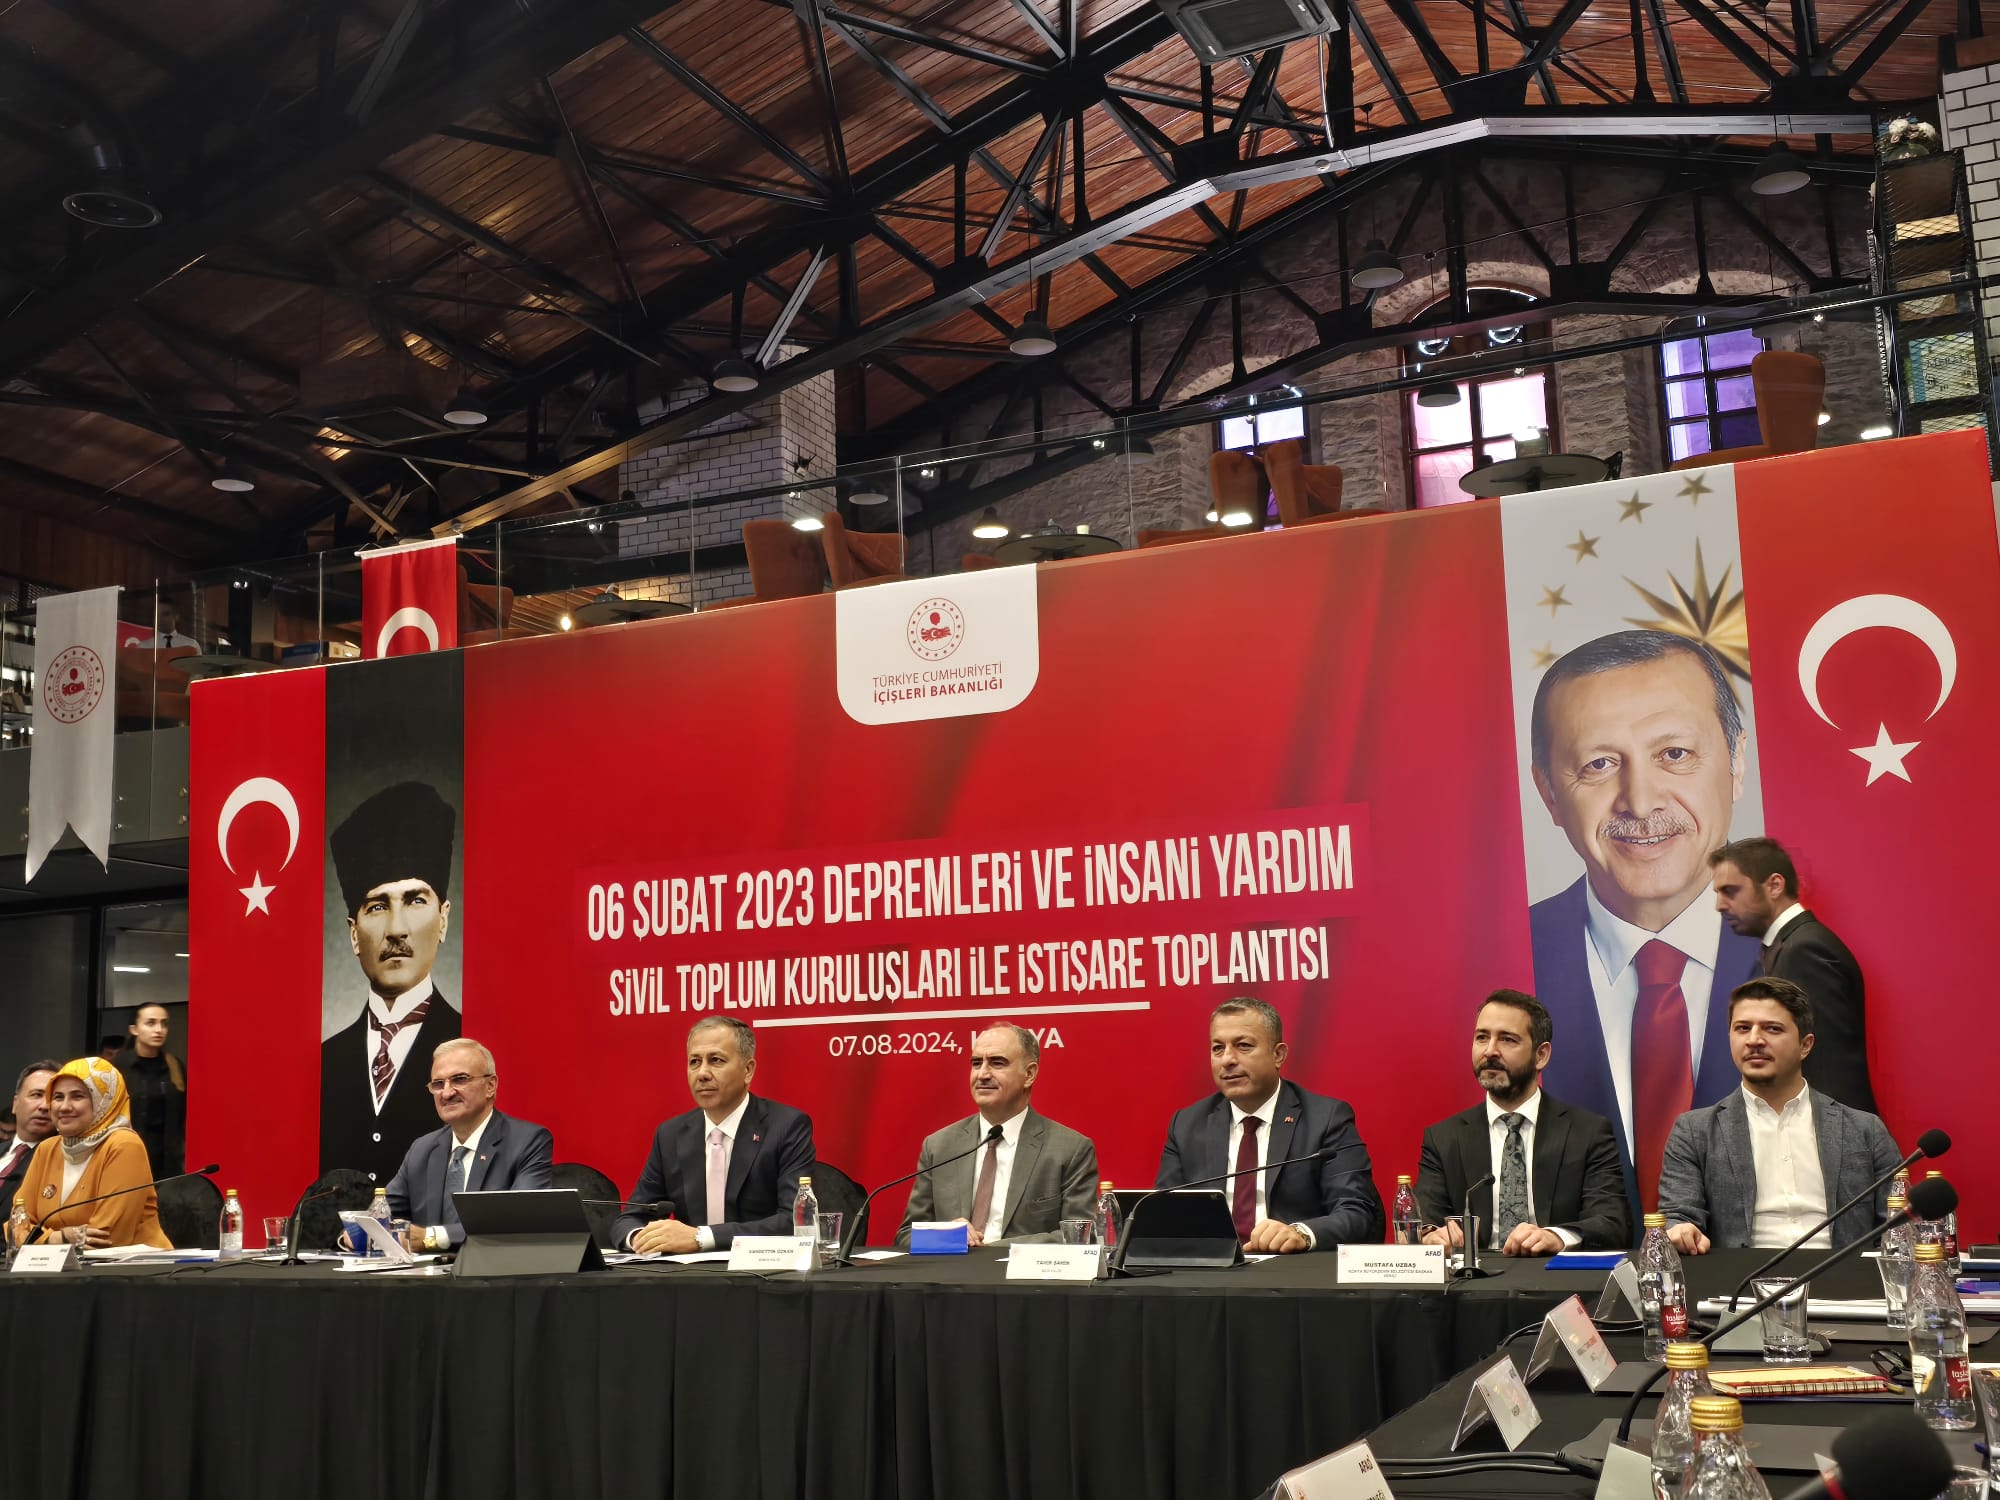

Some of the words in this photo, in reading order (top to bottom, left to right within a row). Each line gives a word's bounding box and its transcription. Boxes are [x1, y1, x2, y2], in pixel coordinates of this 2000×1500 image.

[872, 672, 920, 688] TÜRKİYE
[922, 660, 1003, 683] CUMHURİYETİ
[873, 683, 926, 705] İÇİŞLERİ
[930, 676, 1003, 697] BAKANLIĞI
[588, 882, 625, 941] 06
[632, 874, 728, 942] ŞUBAT
[736, 867, 814, 930] 2023
[824, 851, 1022, 924] DEPREMLERİ
[1031, 847, 1075, 910] VE
[1084, 836, 1200, 907] İNSANİ
[1209, 824, 1353, 897] YARDIM
[609, 967, 670, 1016] SİVİL
[676, 959, 776, 1012] TOPLUM
[784, 948, 961, 1006] KURULUŞLARI
[969, 945, 1010, 996] İLE
[1018, 936, 1145, 995] İSTİŞARE
[1152, 926, 1329, 987] TOPLANTISI
[828, 1031, 963, 1057] 07.08.2024,
[1358, 1458, 1374, 1474] AFAD
